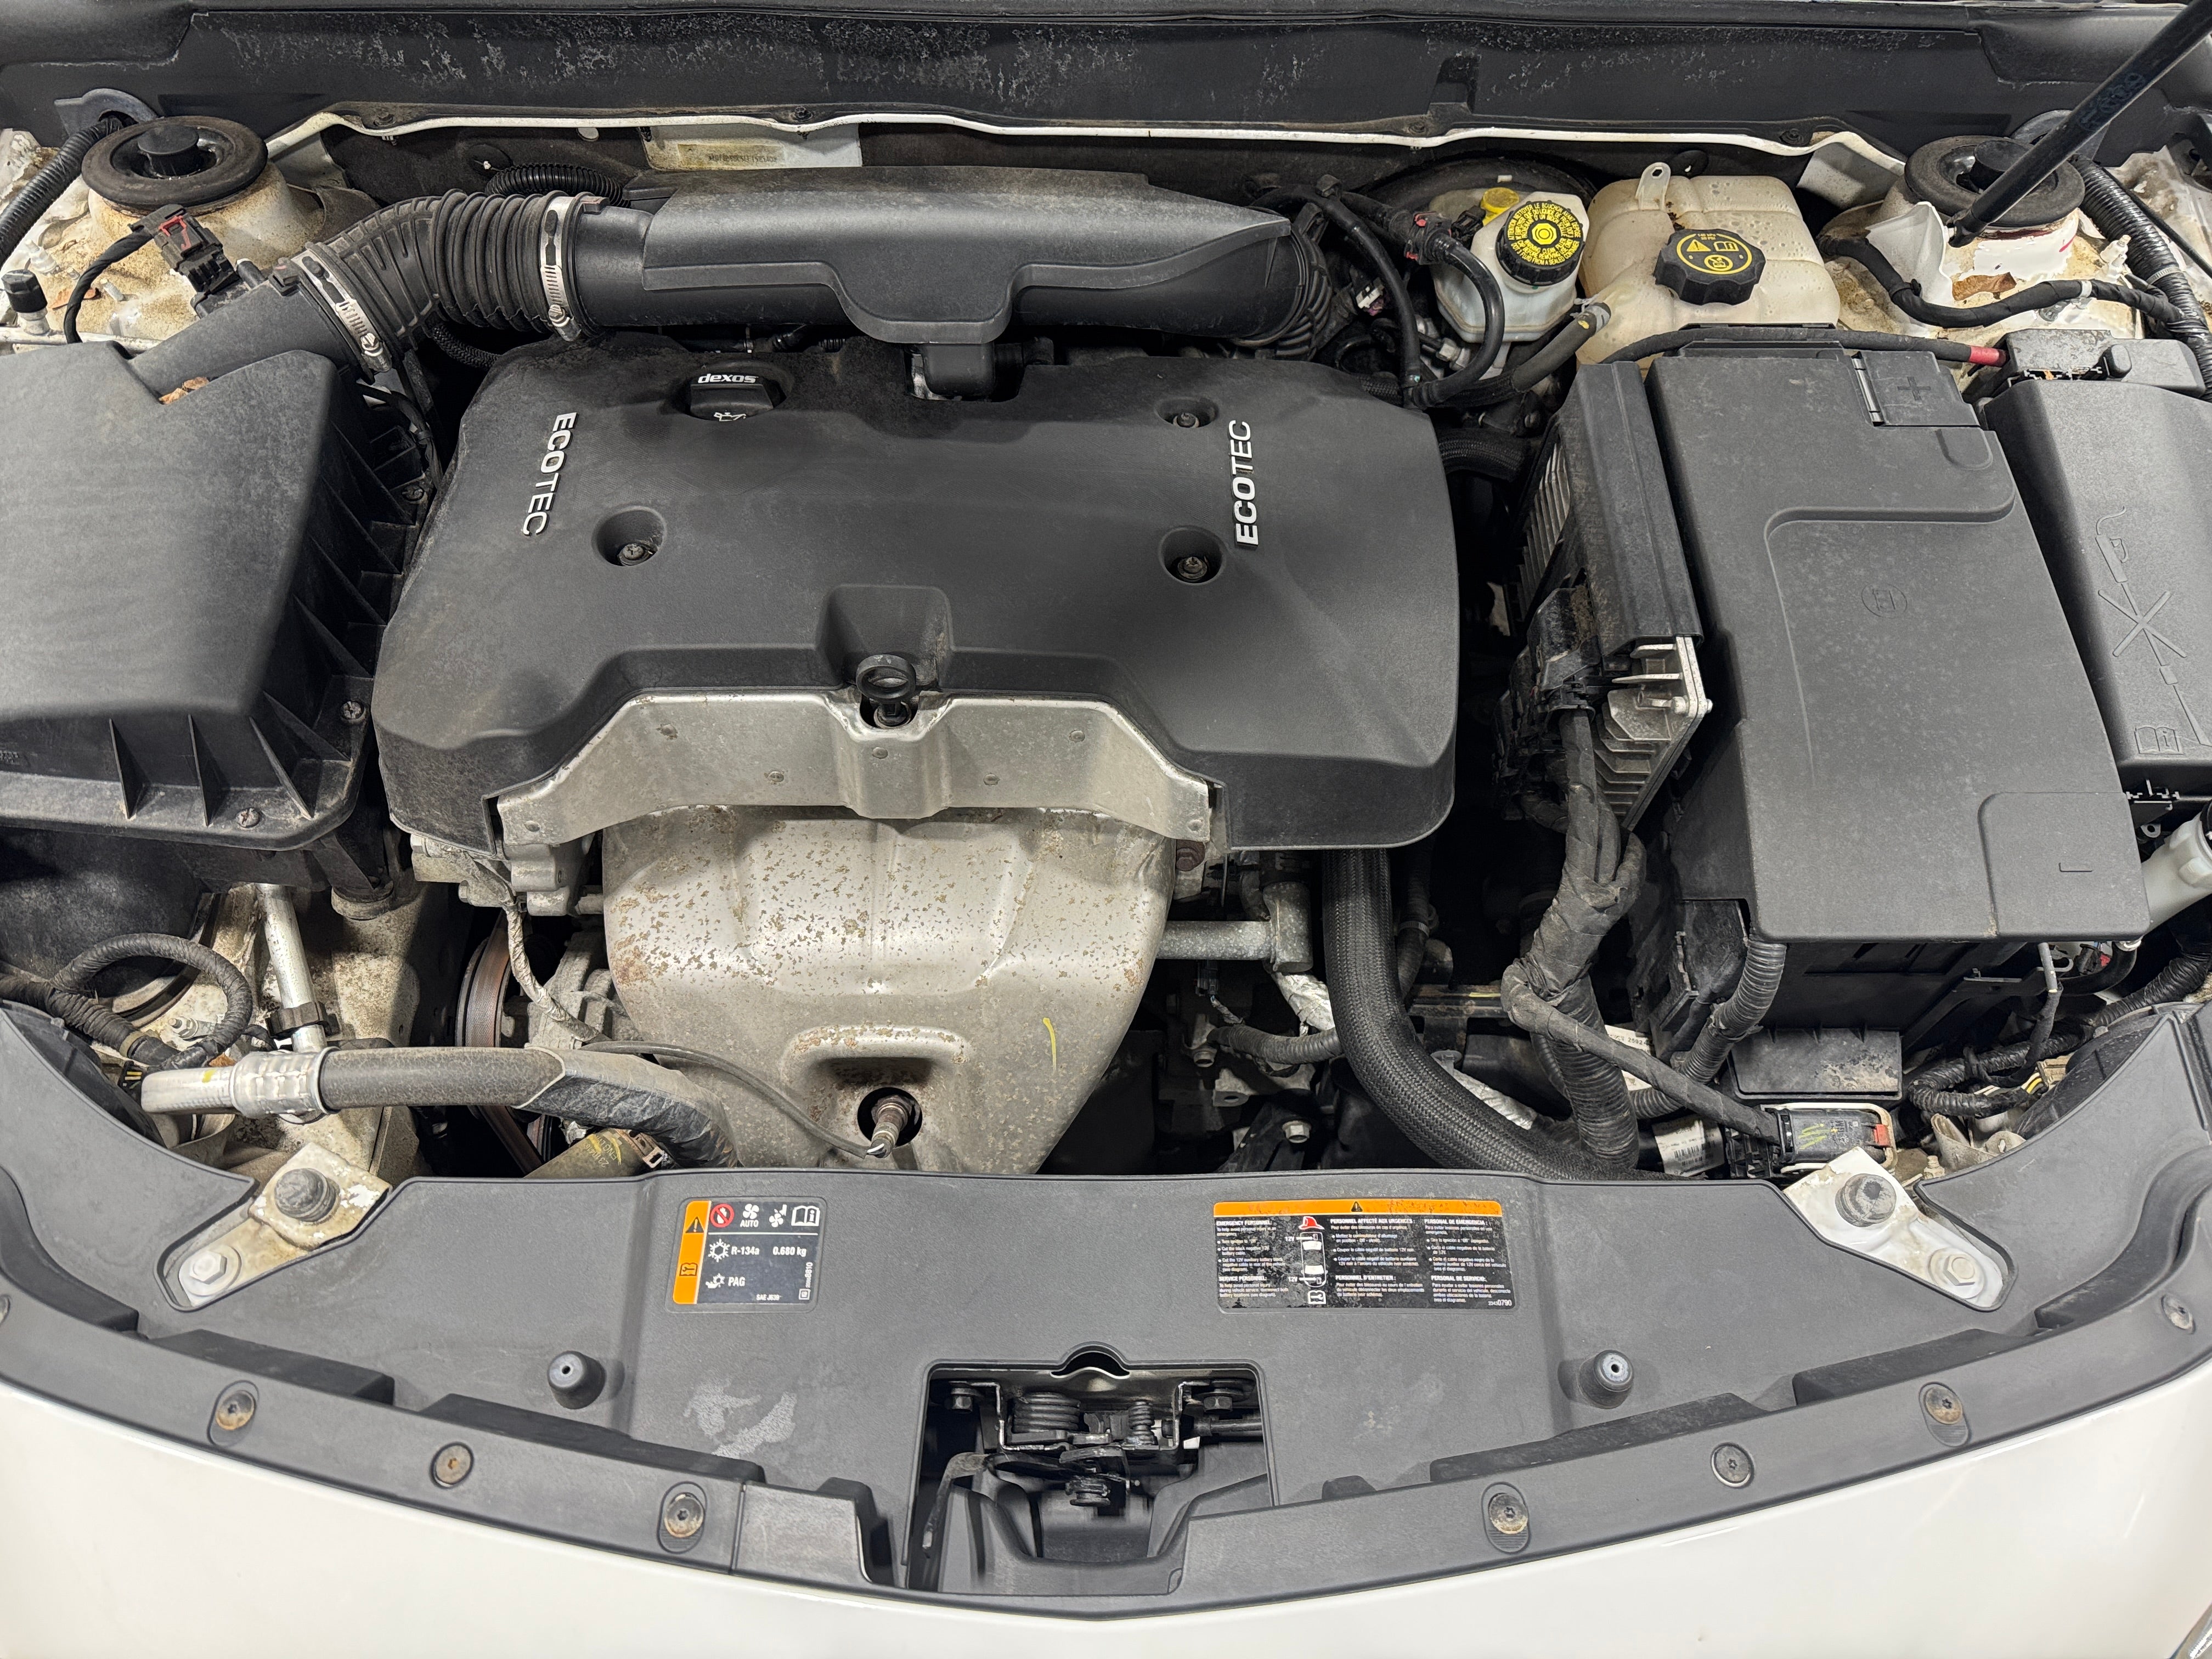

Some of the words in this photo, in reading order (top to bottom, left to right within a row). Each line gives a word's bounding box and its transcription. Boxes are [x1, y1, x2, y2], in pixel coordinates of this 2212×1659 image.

[1513, 205, 1533, 219] NETTOYER
[1542, 203, 1563, 213] BOUCHON
[1562, 211, 1576, 223] AVANT
[1560, 216, 1571, 228] FREIN
[1511, 242, 1519, 252] DOT
[1520, 252, 1532, 262] FLUID
[1549, 256, 1565, 266] SEALED
[698, 374, 757, 383] dexos
[523, 411, 577, 535] ECOTEC
[1228, 420, 1259, 545] ECOTEC
[731, 1246, 759, 1255] R-134a
[772, 1247, 795, 1255] 0.680
[797, 1247, 806, 1257] kg
[727, 1277, 746, 1286] PAG
